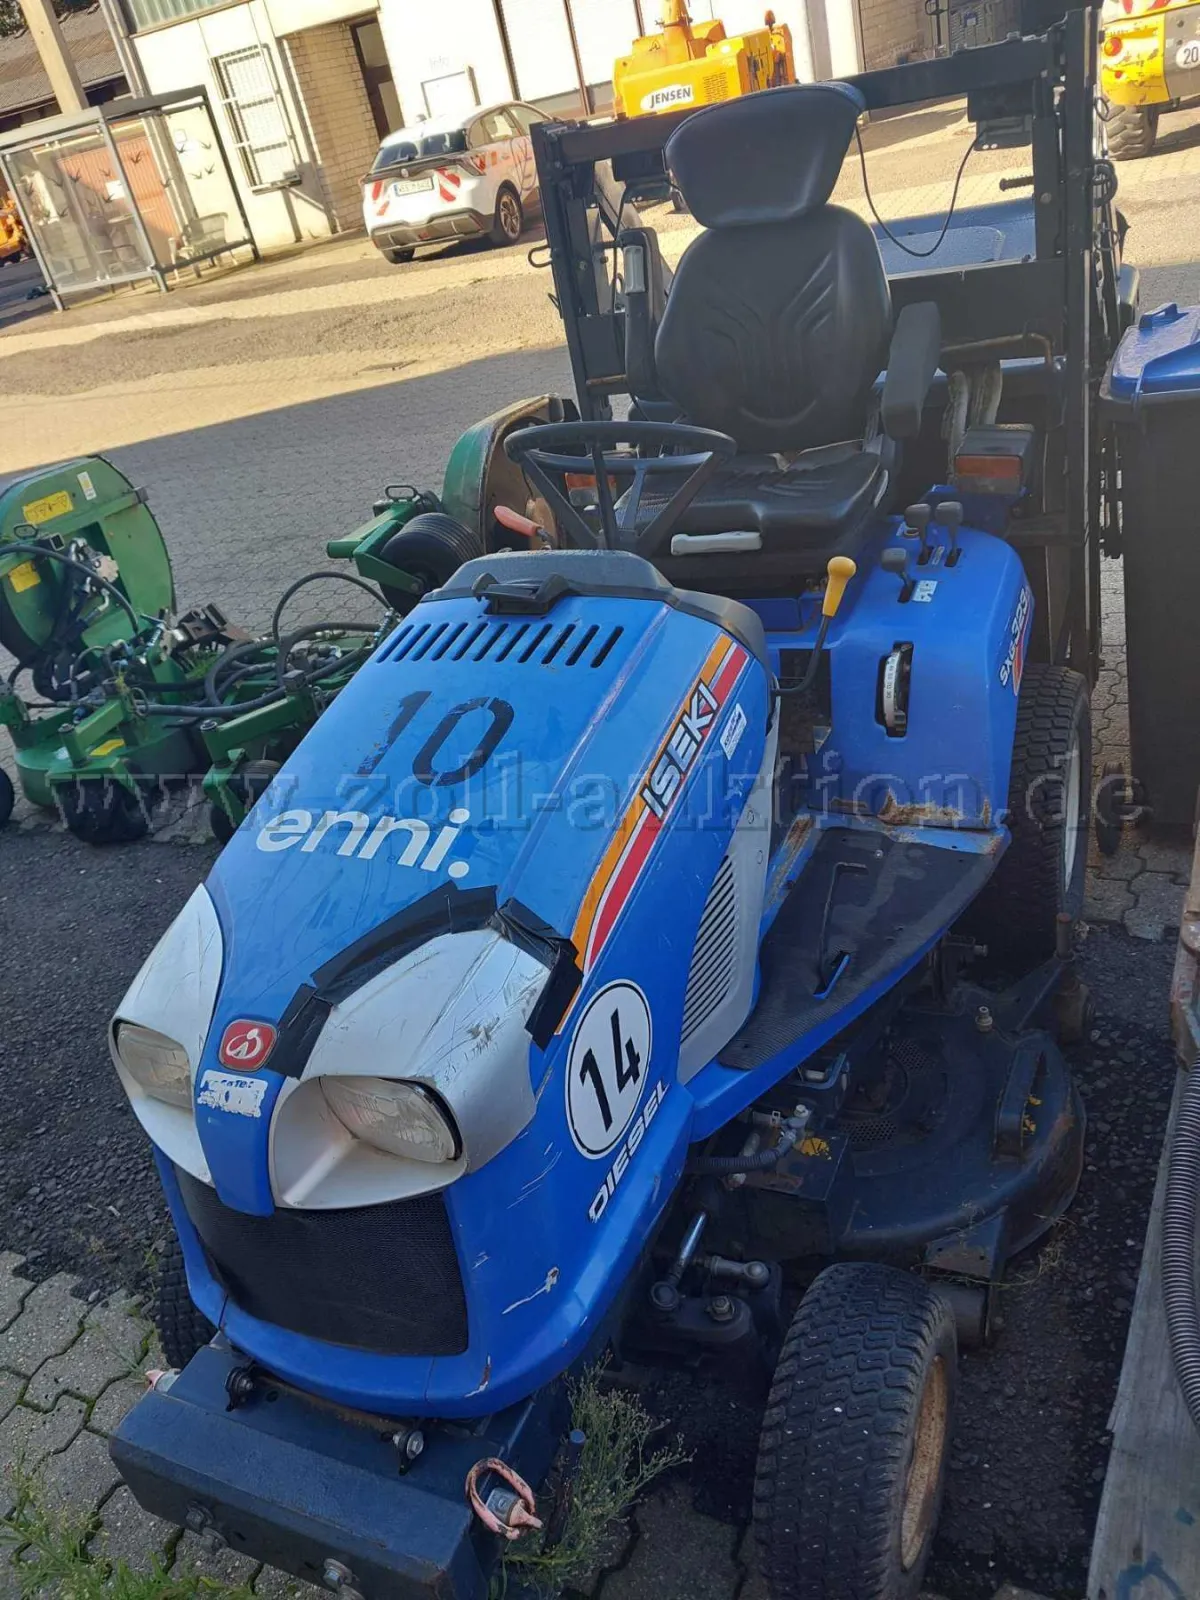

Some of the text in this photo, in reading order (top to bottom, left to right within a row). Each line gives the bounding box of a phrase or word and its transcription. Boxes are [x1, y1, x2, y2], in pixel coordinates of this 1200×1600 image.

[650, 87, 691, 109] JENSEN
[1183, 46, 1199, 65] 20
[354, 689, 515, 788] 10
[640, 679, 720, 821] ISEKI
[255, 807, 471, 879] enni.
[579, 1007, 641, 1134] 14
[588, 1078, 671, 1224] DIESEL
